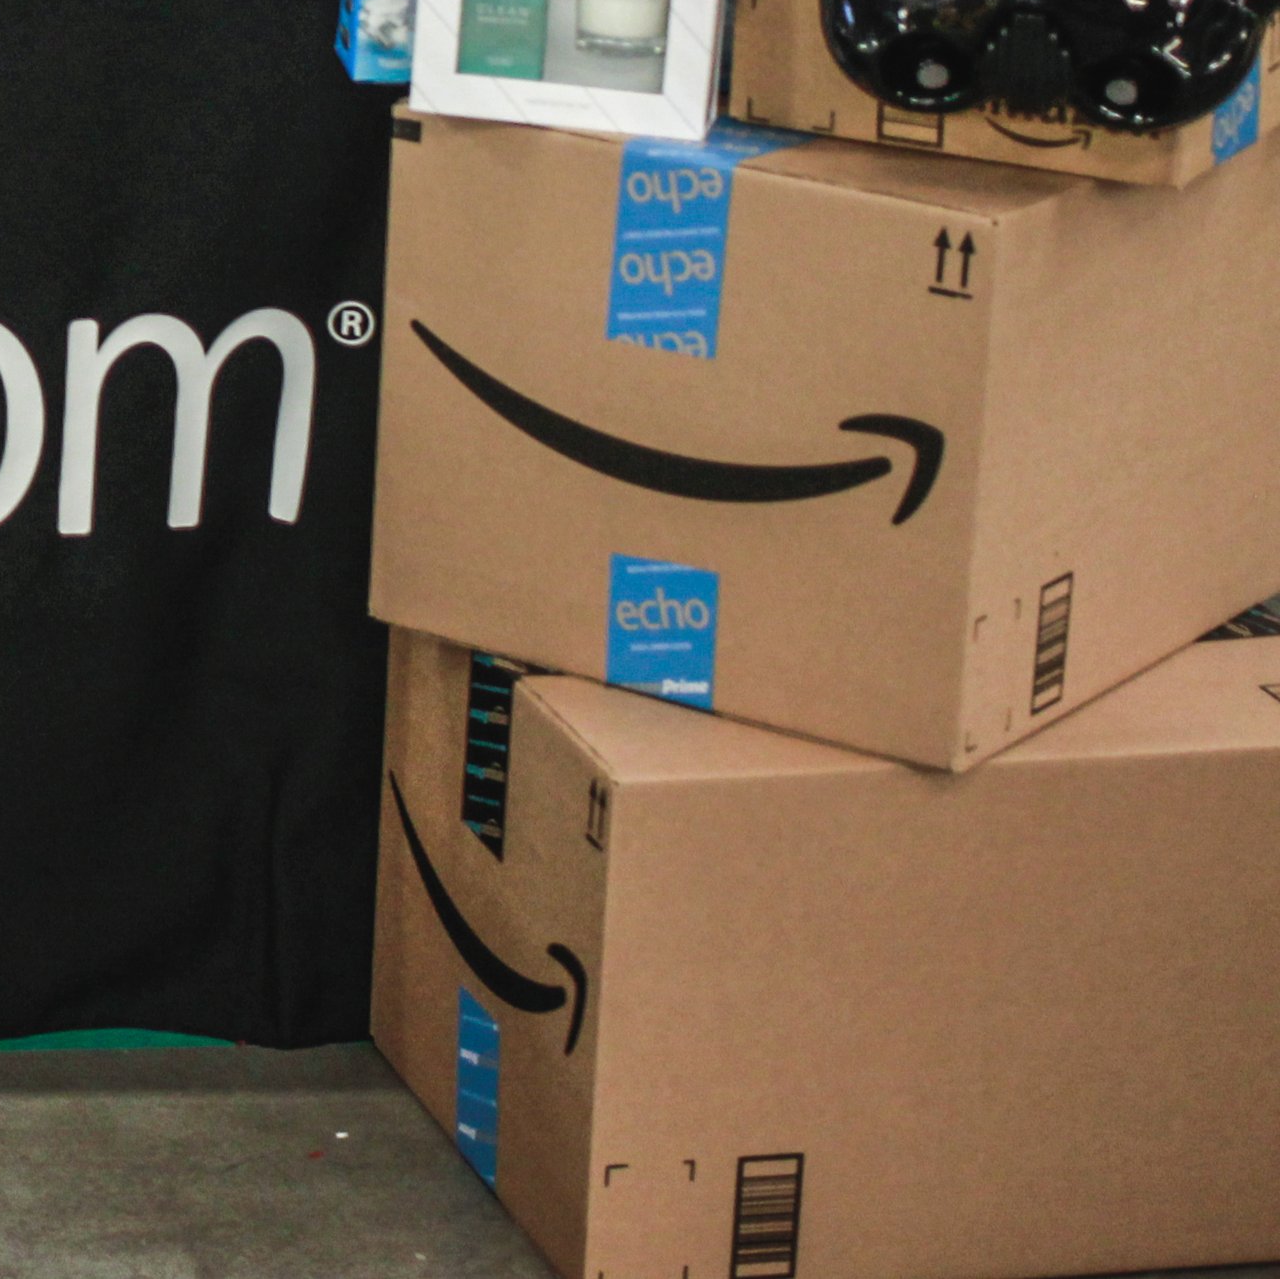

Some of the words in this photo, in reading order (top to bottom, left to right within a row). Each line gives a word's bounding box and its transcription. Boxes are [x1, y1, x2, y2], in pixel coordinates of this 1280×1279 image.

[627, 167, 724, 214] echo
[619, 248, 715, 296] echo
[616, 587, 710, 631] echo
